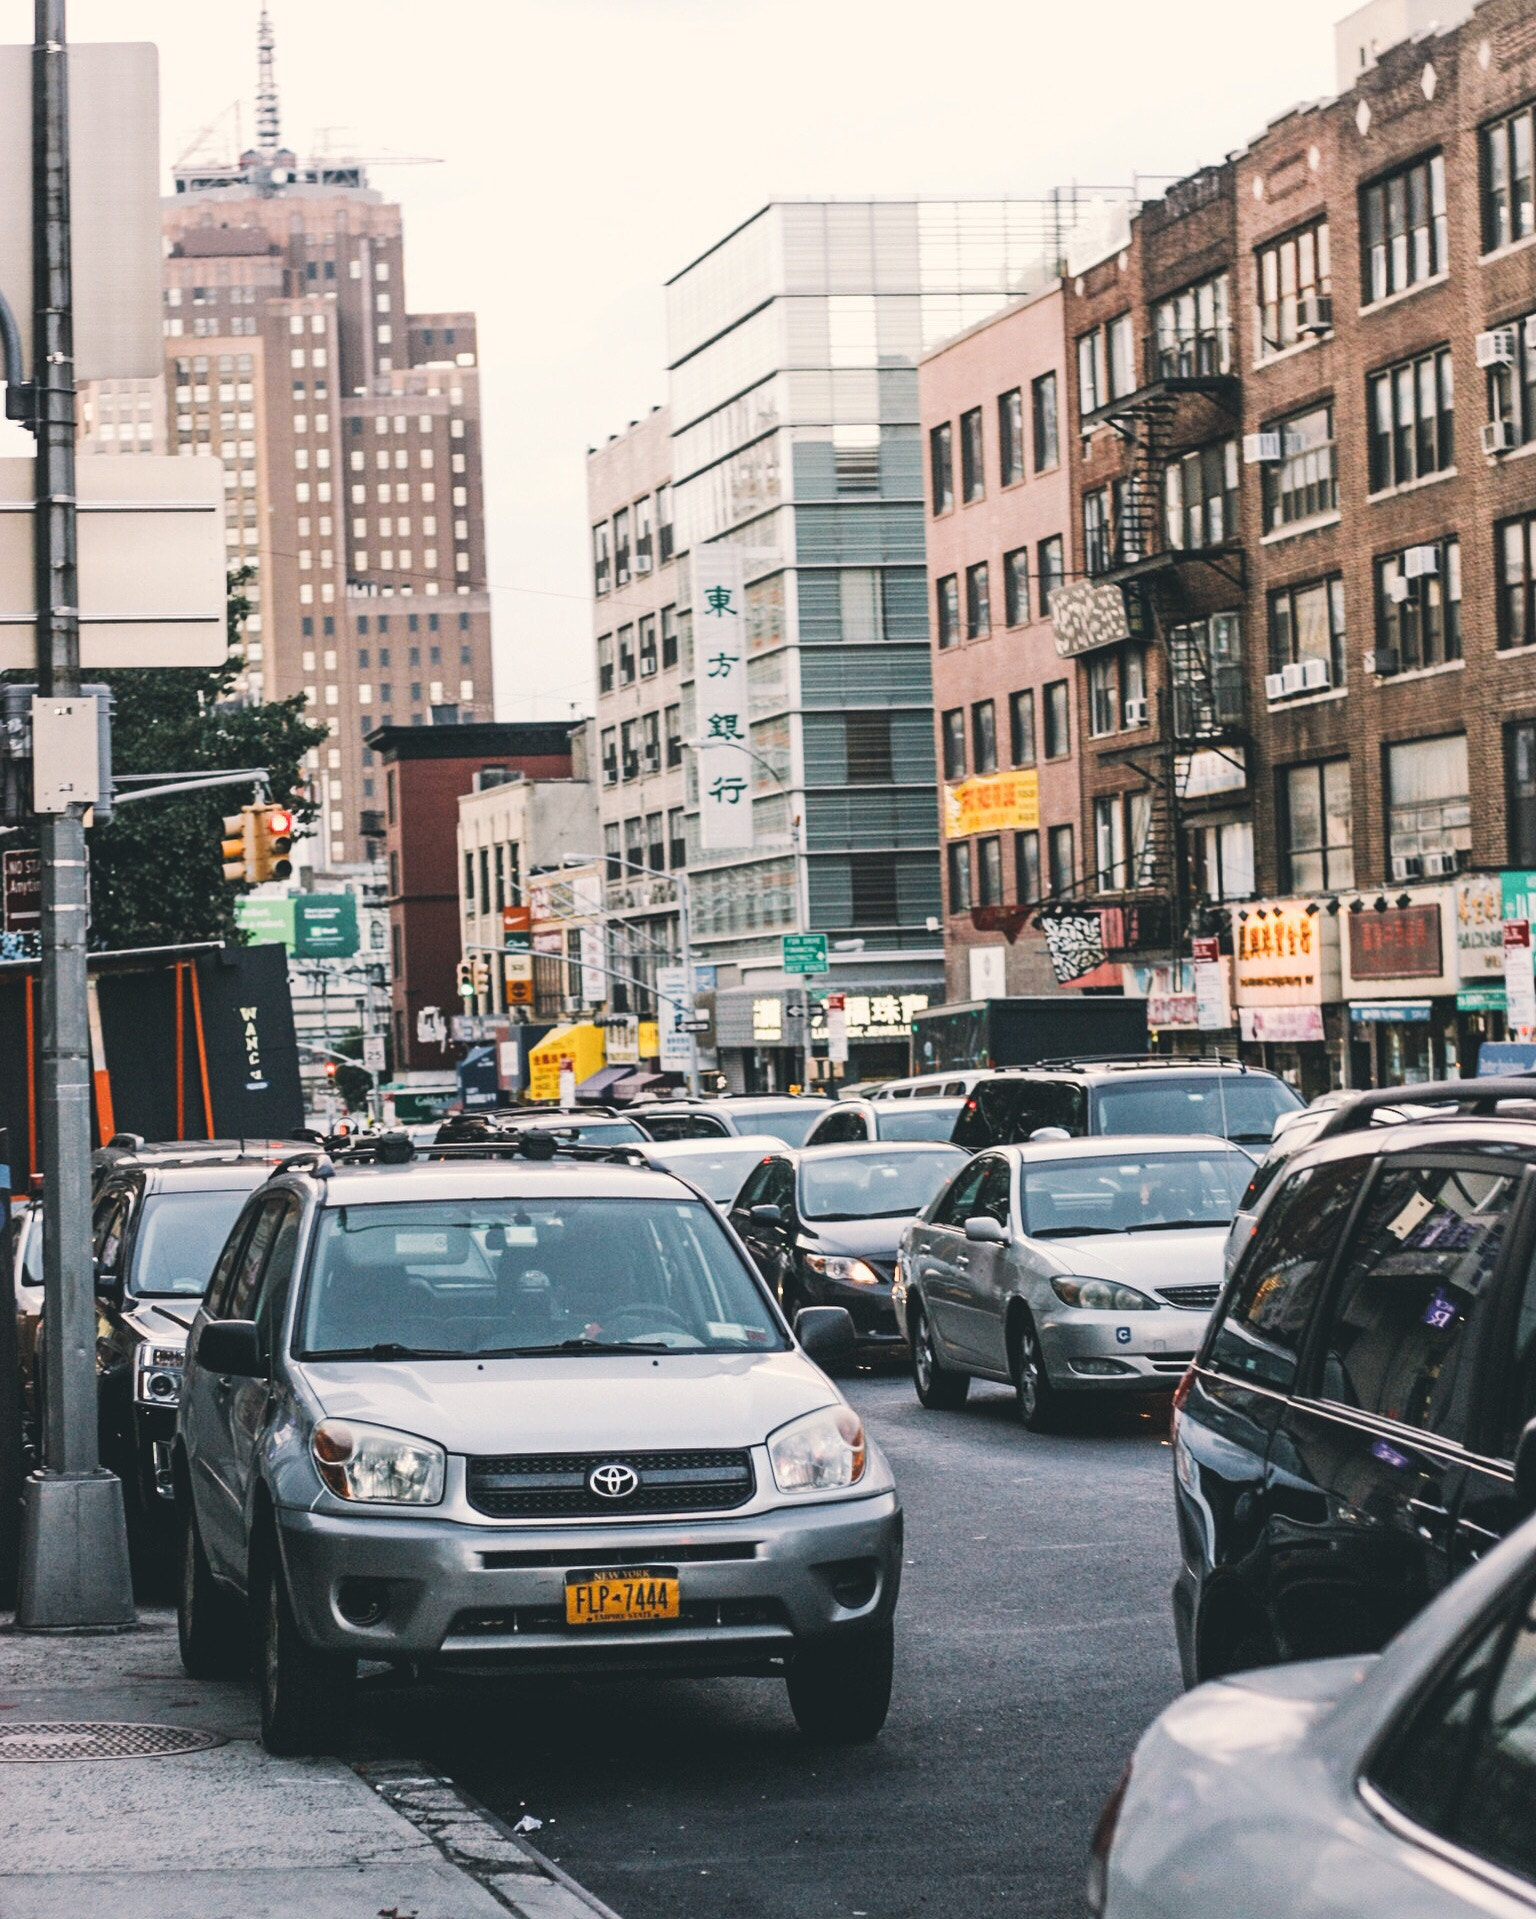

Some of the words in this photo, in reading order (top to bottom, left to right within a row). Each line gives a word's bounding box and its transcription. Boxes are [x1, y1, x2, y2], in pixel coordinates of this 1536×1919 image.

[704, 585, 749, 805] 東方銀行
[367, 1050, 382, 1061] 25
[593, 1571, 619, 1580] NEW
[622, 1569, 650, 1579] YORK
[594, 1613, 624, 1622] EMPIRE
[627, 1611, 652, 1620] STATE
